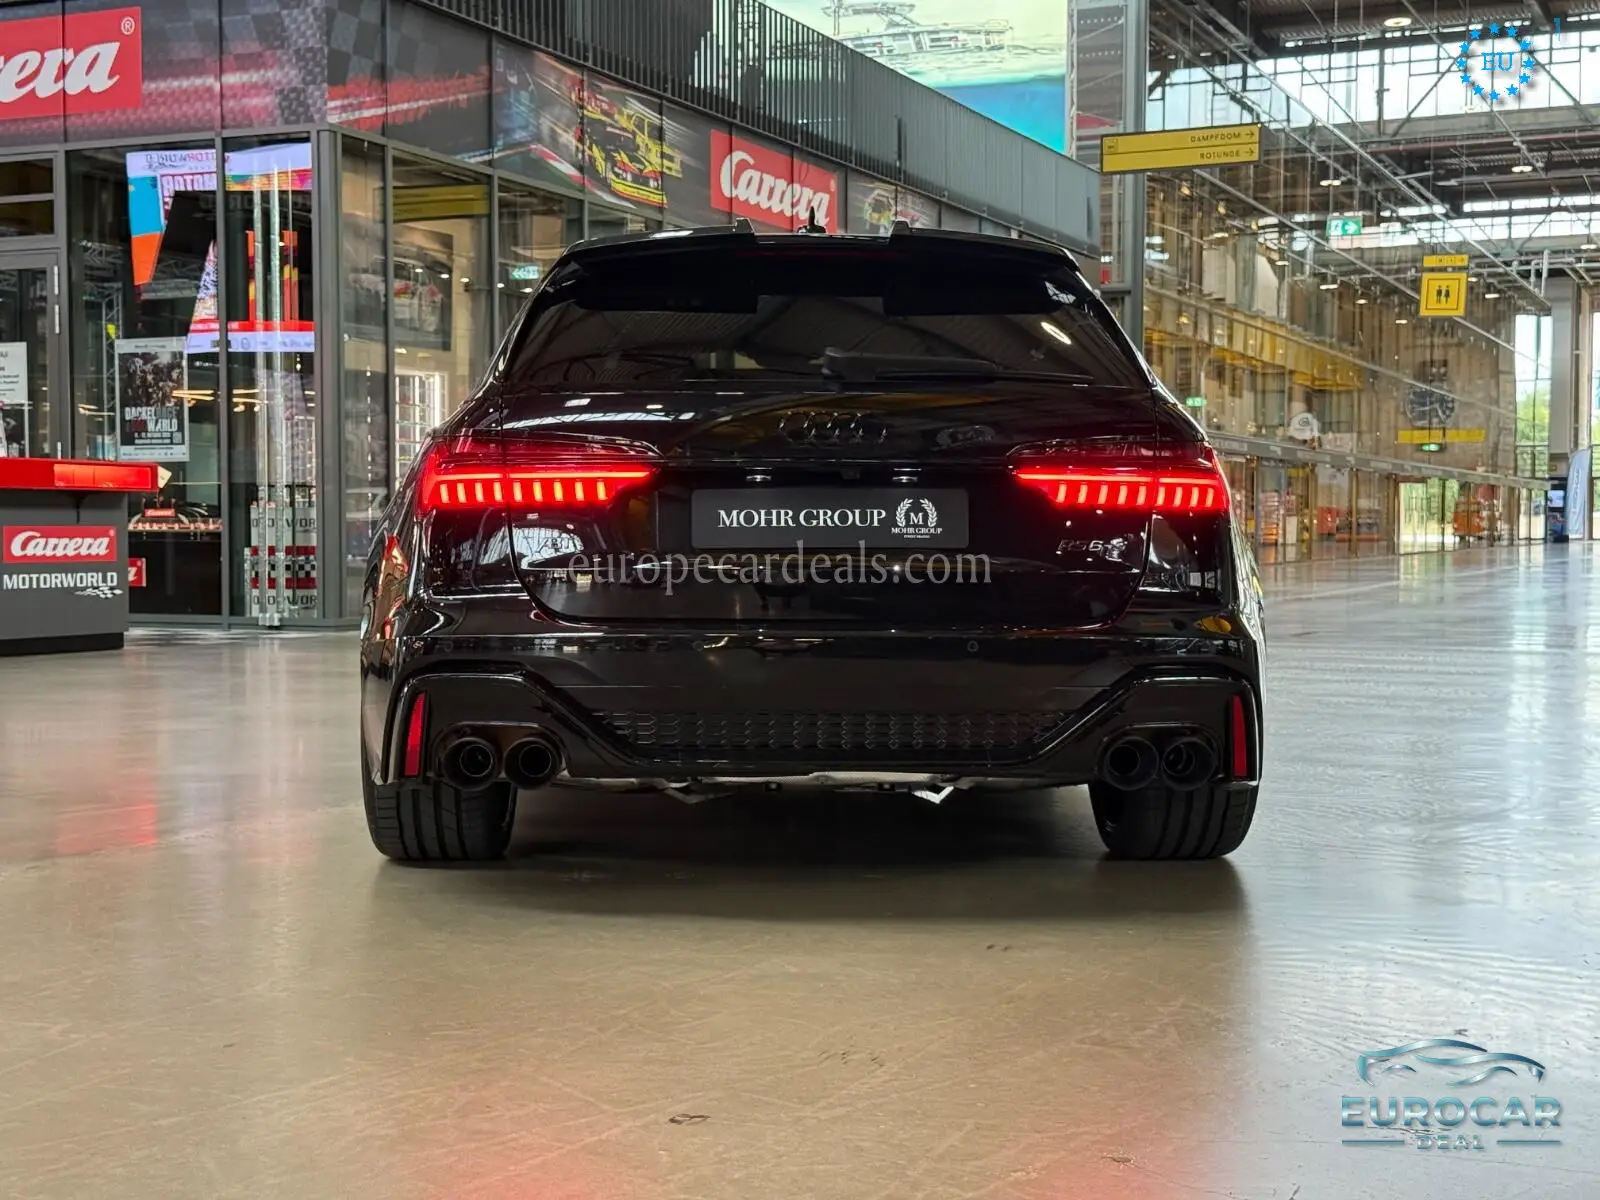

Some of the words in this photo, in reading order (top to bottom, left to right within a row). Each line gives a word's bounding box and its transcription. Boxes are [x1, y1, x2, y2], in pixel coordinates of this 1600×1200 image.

[0, 41, 120, 103] era
[1191, 131, 1241, 143] DAMPFDOM
[1200, 150, 1240, 159] ROTUNDE
[720, 150, 830, 226] Carrera
[717, 509, 796, 528] MOHR
[799, 508, 887, 527] GROUP
[909, 513, 924, 525] M
[11, 531, 110, 557] Carrera
[3, 571, 118, 590] MOTORWORLD
